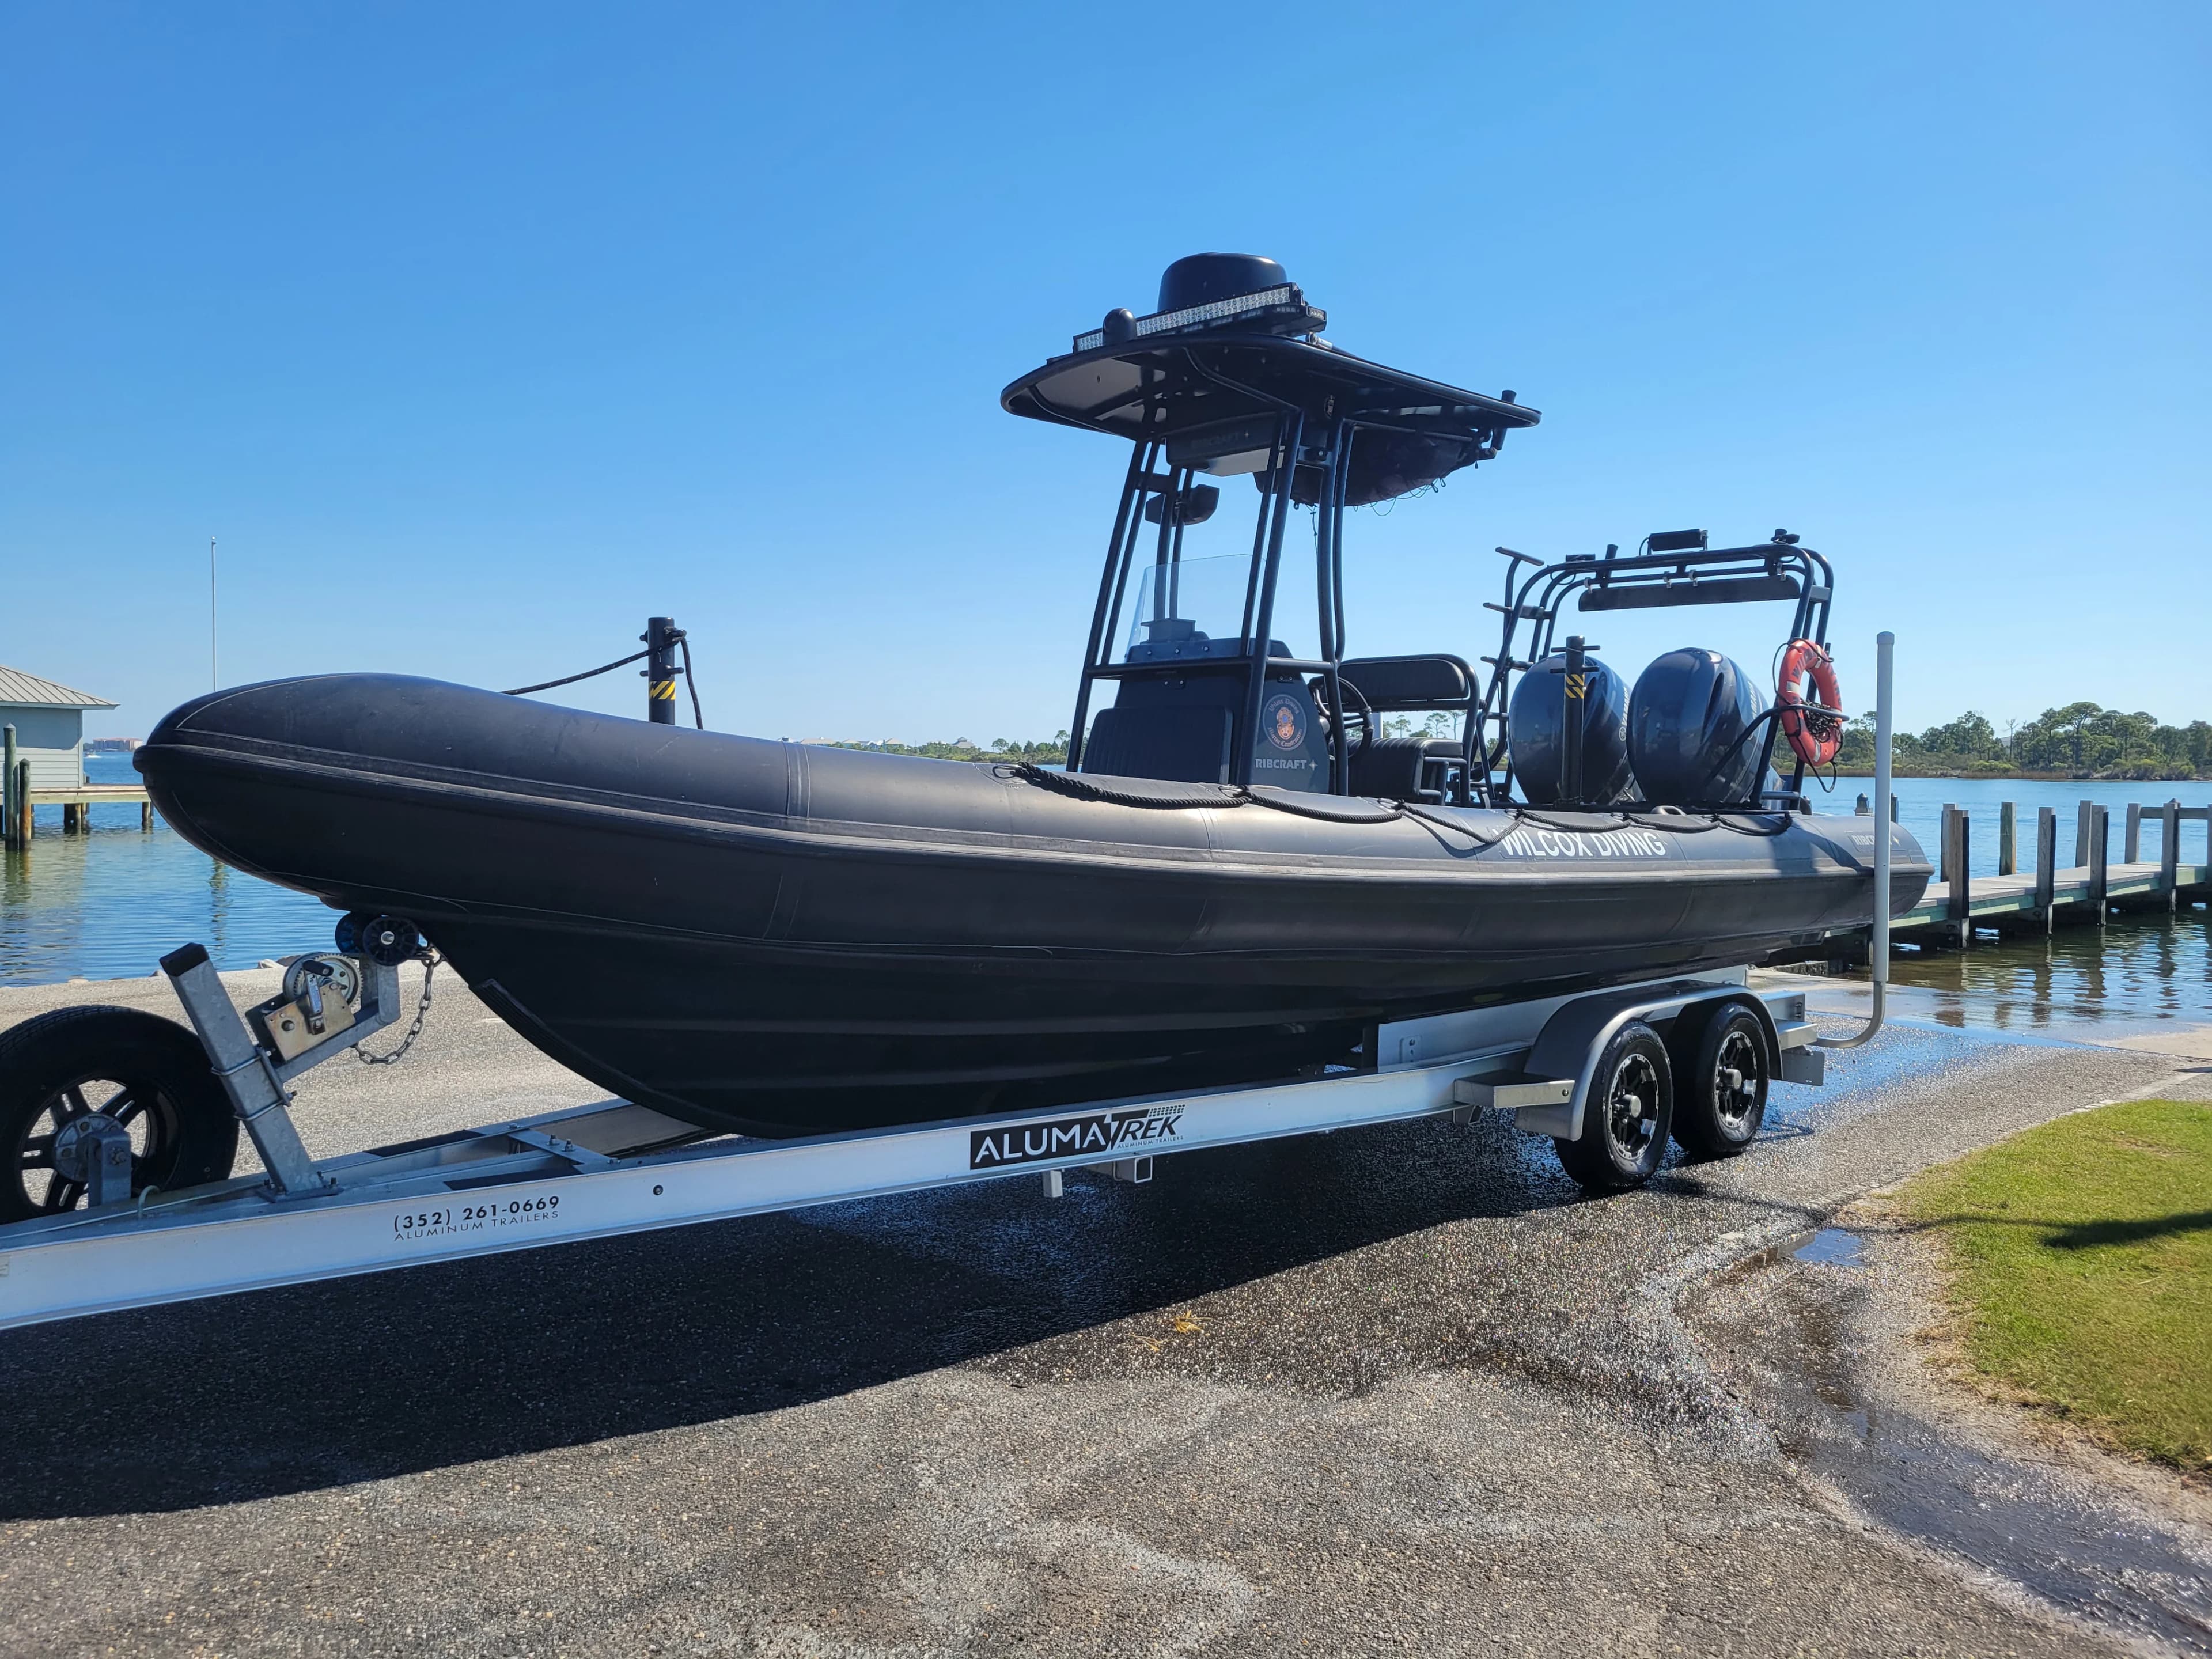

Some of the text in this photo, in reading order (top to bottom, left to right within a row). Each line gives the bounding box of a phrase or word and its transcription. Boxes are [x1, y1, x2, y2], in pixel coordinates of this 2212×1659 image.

[1255, 758, 1307, 770] RIBCRAFT
[1492, 828, 1667, 857] WILCOX DIVING
[1117, 1135, 1184, 1149] ALUMINUM TRAILERS
[394, 1195, 559, 1232] (352) 261-0669
[394, 1210, 559, 1241] ALUMINUM TRAILERS
